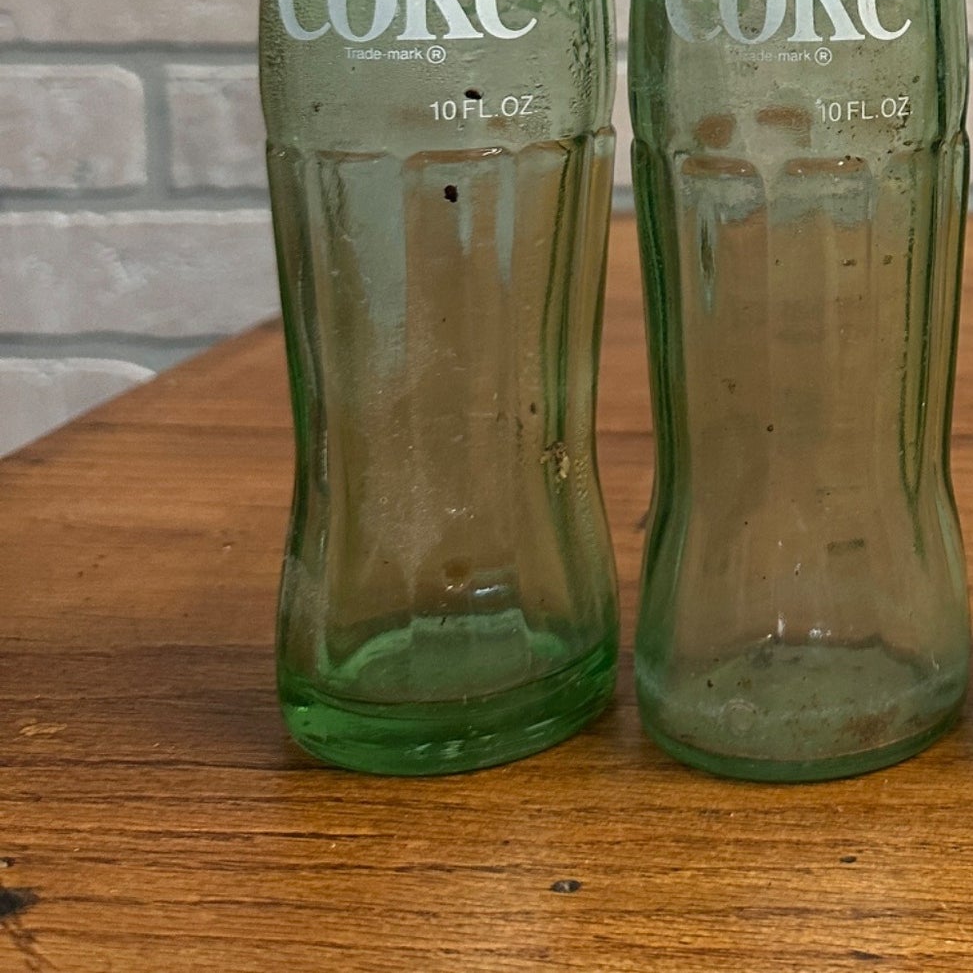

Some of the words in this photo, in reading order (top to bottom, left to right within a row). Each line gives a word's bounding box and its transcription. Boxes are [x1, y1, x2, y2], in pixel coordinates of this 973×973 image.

[344, 47, 423, 60] Trade-mark
[429, 100, 457, 121] 10
[818, 101, 841, 122] 10
